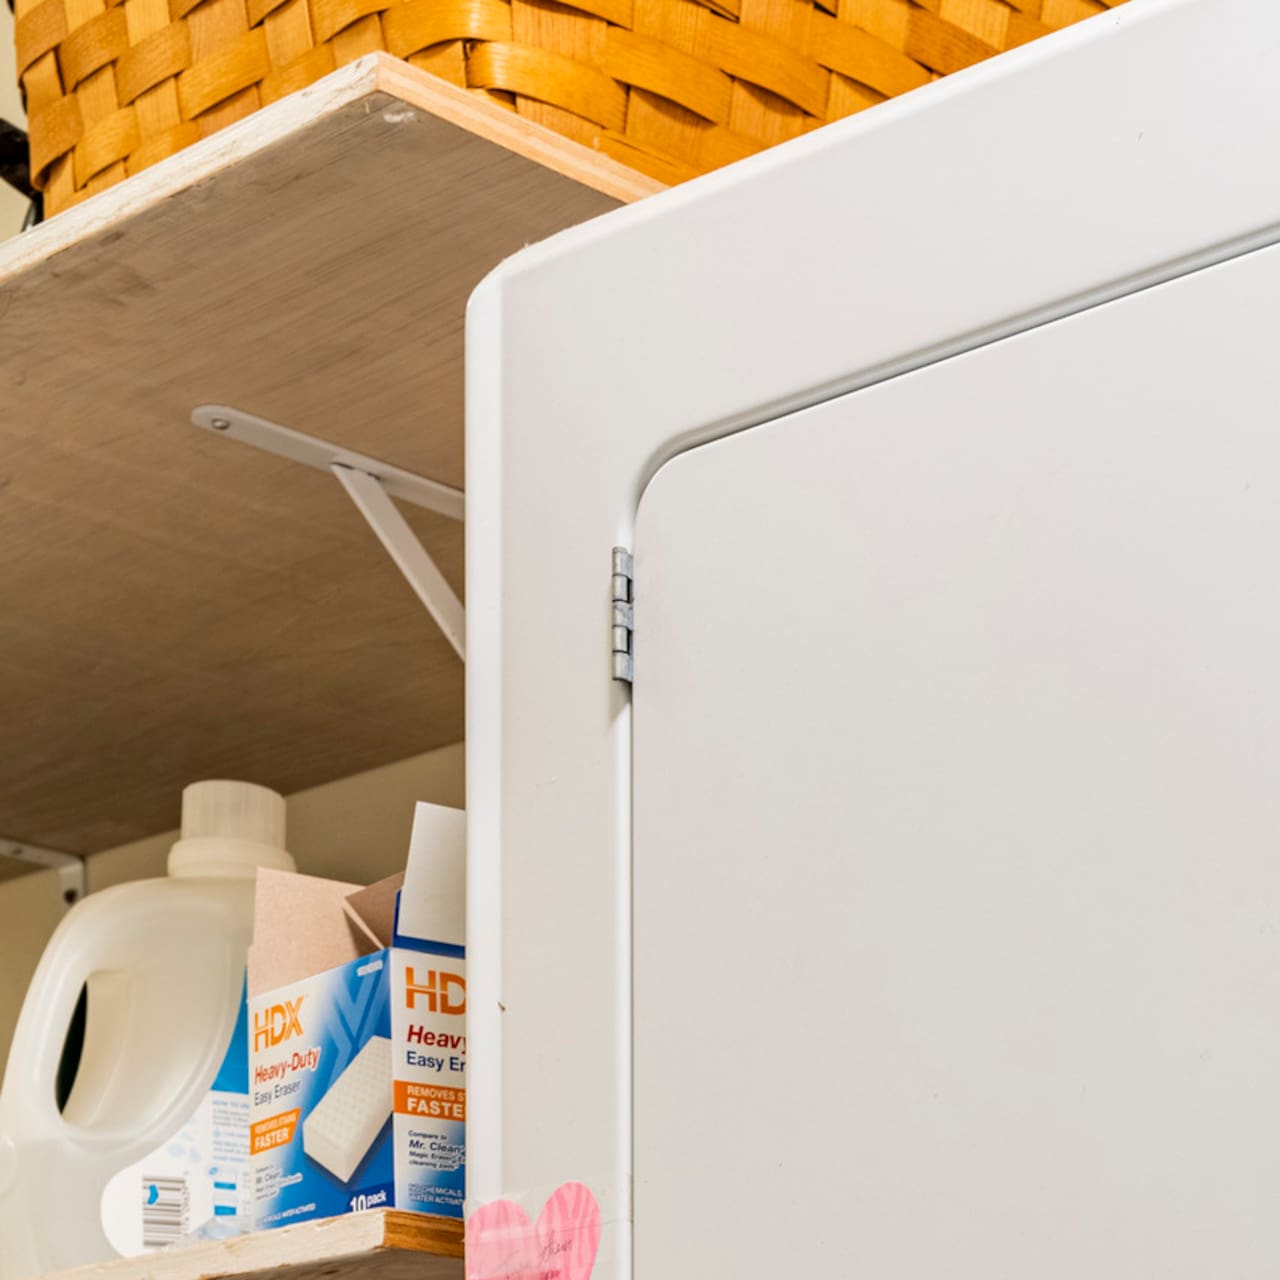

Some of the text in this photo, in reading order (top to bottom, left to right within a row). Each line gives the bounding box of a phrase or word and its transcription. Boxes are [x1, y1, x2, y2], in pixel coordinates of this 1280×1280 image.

[405, 967, 466, 1015] HD
[254, 996, 304, 1052] HDX
[255, 1047, 320, 1086] Heavy-Duty
[406, 1051, 443, 1072] Easy
[254, 1088, 272, 1107] Easy
[275, 1080, 301, 1100] Eraser
[407, 1085, 457, 1100] REMOVES
[407, 1098, 465, 1118] FASTE
[255, 1127, 289, 1150] FASTER
[409, 1140, 461, 1154] Mr. Clean
[350, 1195, 366, 1213] 10
[367, 1189, 387, 1209] pack
